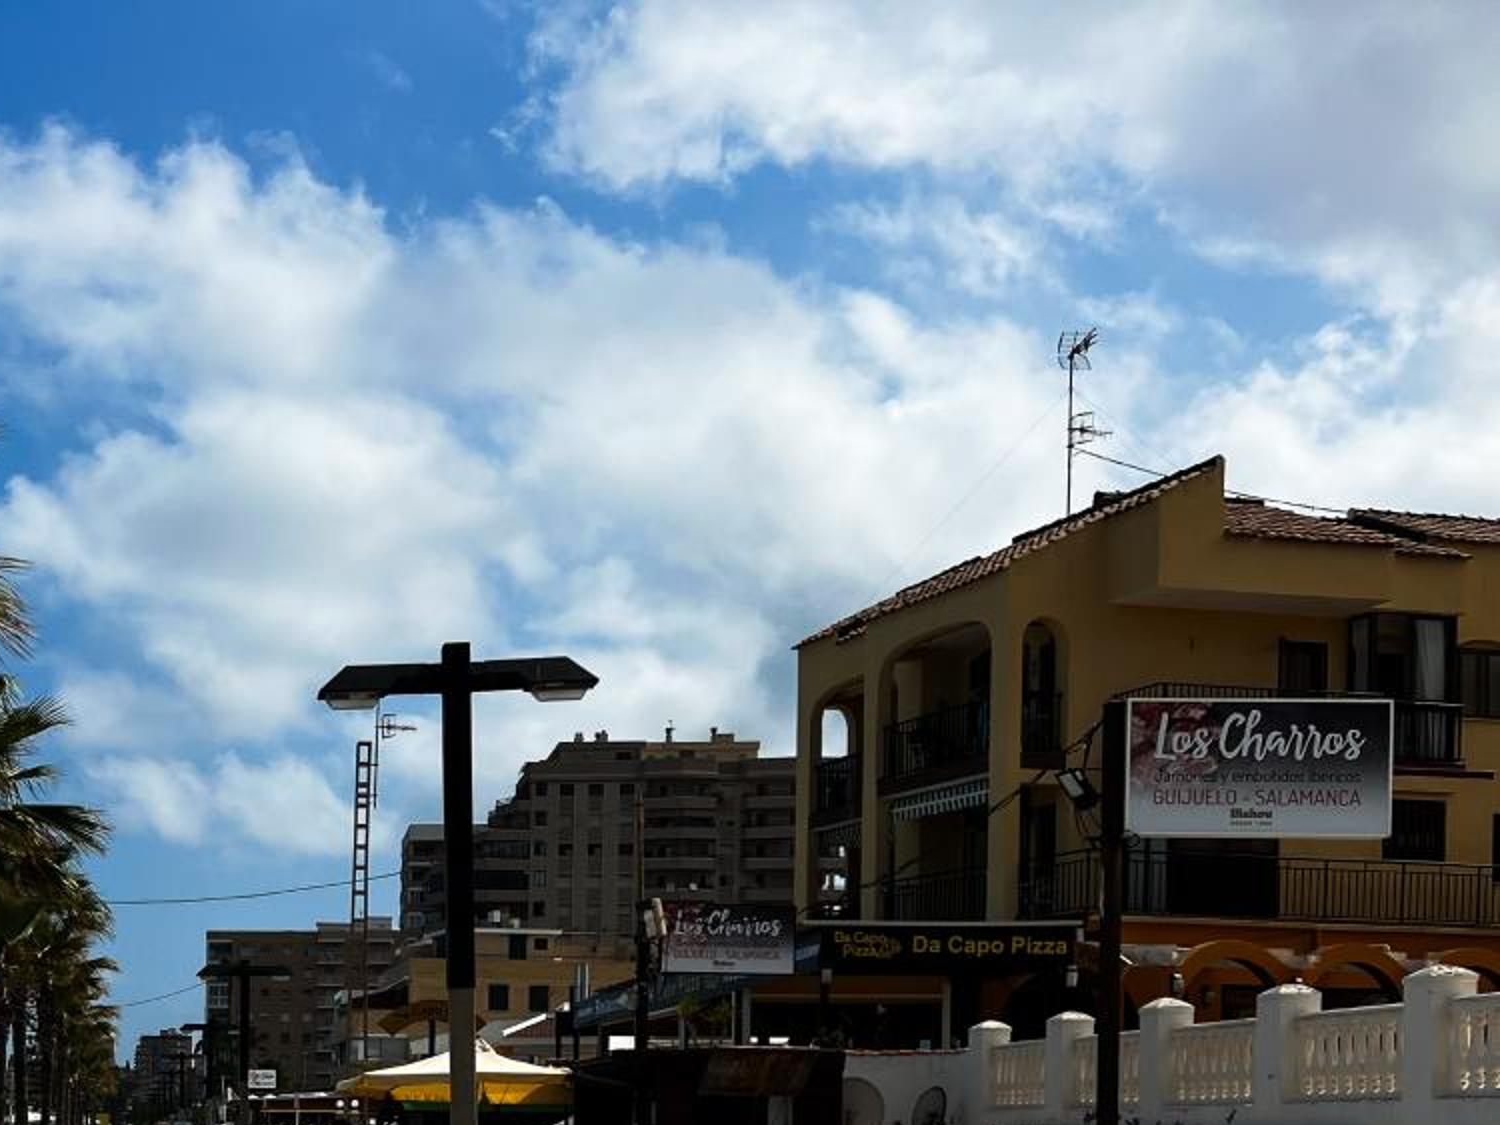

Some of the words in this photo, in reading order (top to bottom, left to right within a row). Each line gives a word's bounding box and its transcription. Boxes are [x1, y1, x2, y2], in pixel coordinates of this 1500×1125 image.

[1153, 710, 1213, 761] Los
[1219, 708, 1365, 762] Charros
[1153, 788, 1238, 806] GUIJUELO
[1255, 789, 1362, 807] SALAMANCA
[912, 934, 942, 954] Da
[947, 934, 1005, 958] Capo
[1011, 934, 1068, 955] Pizza
